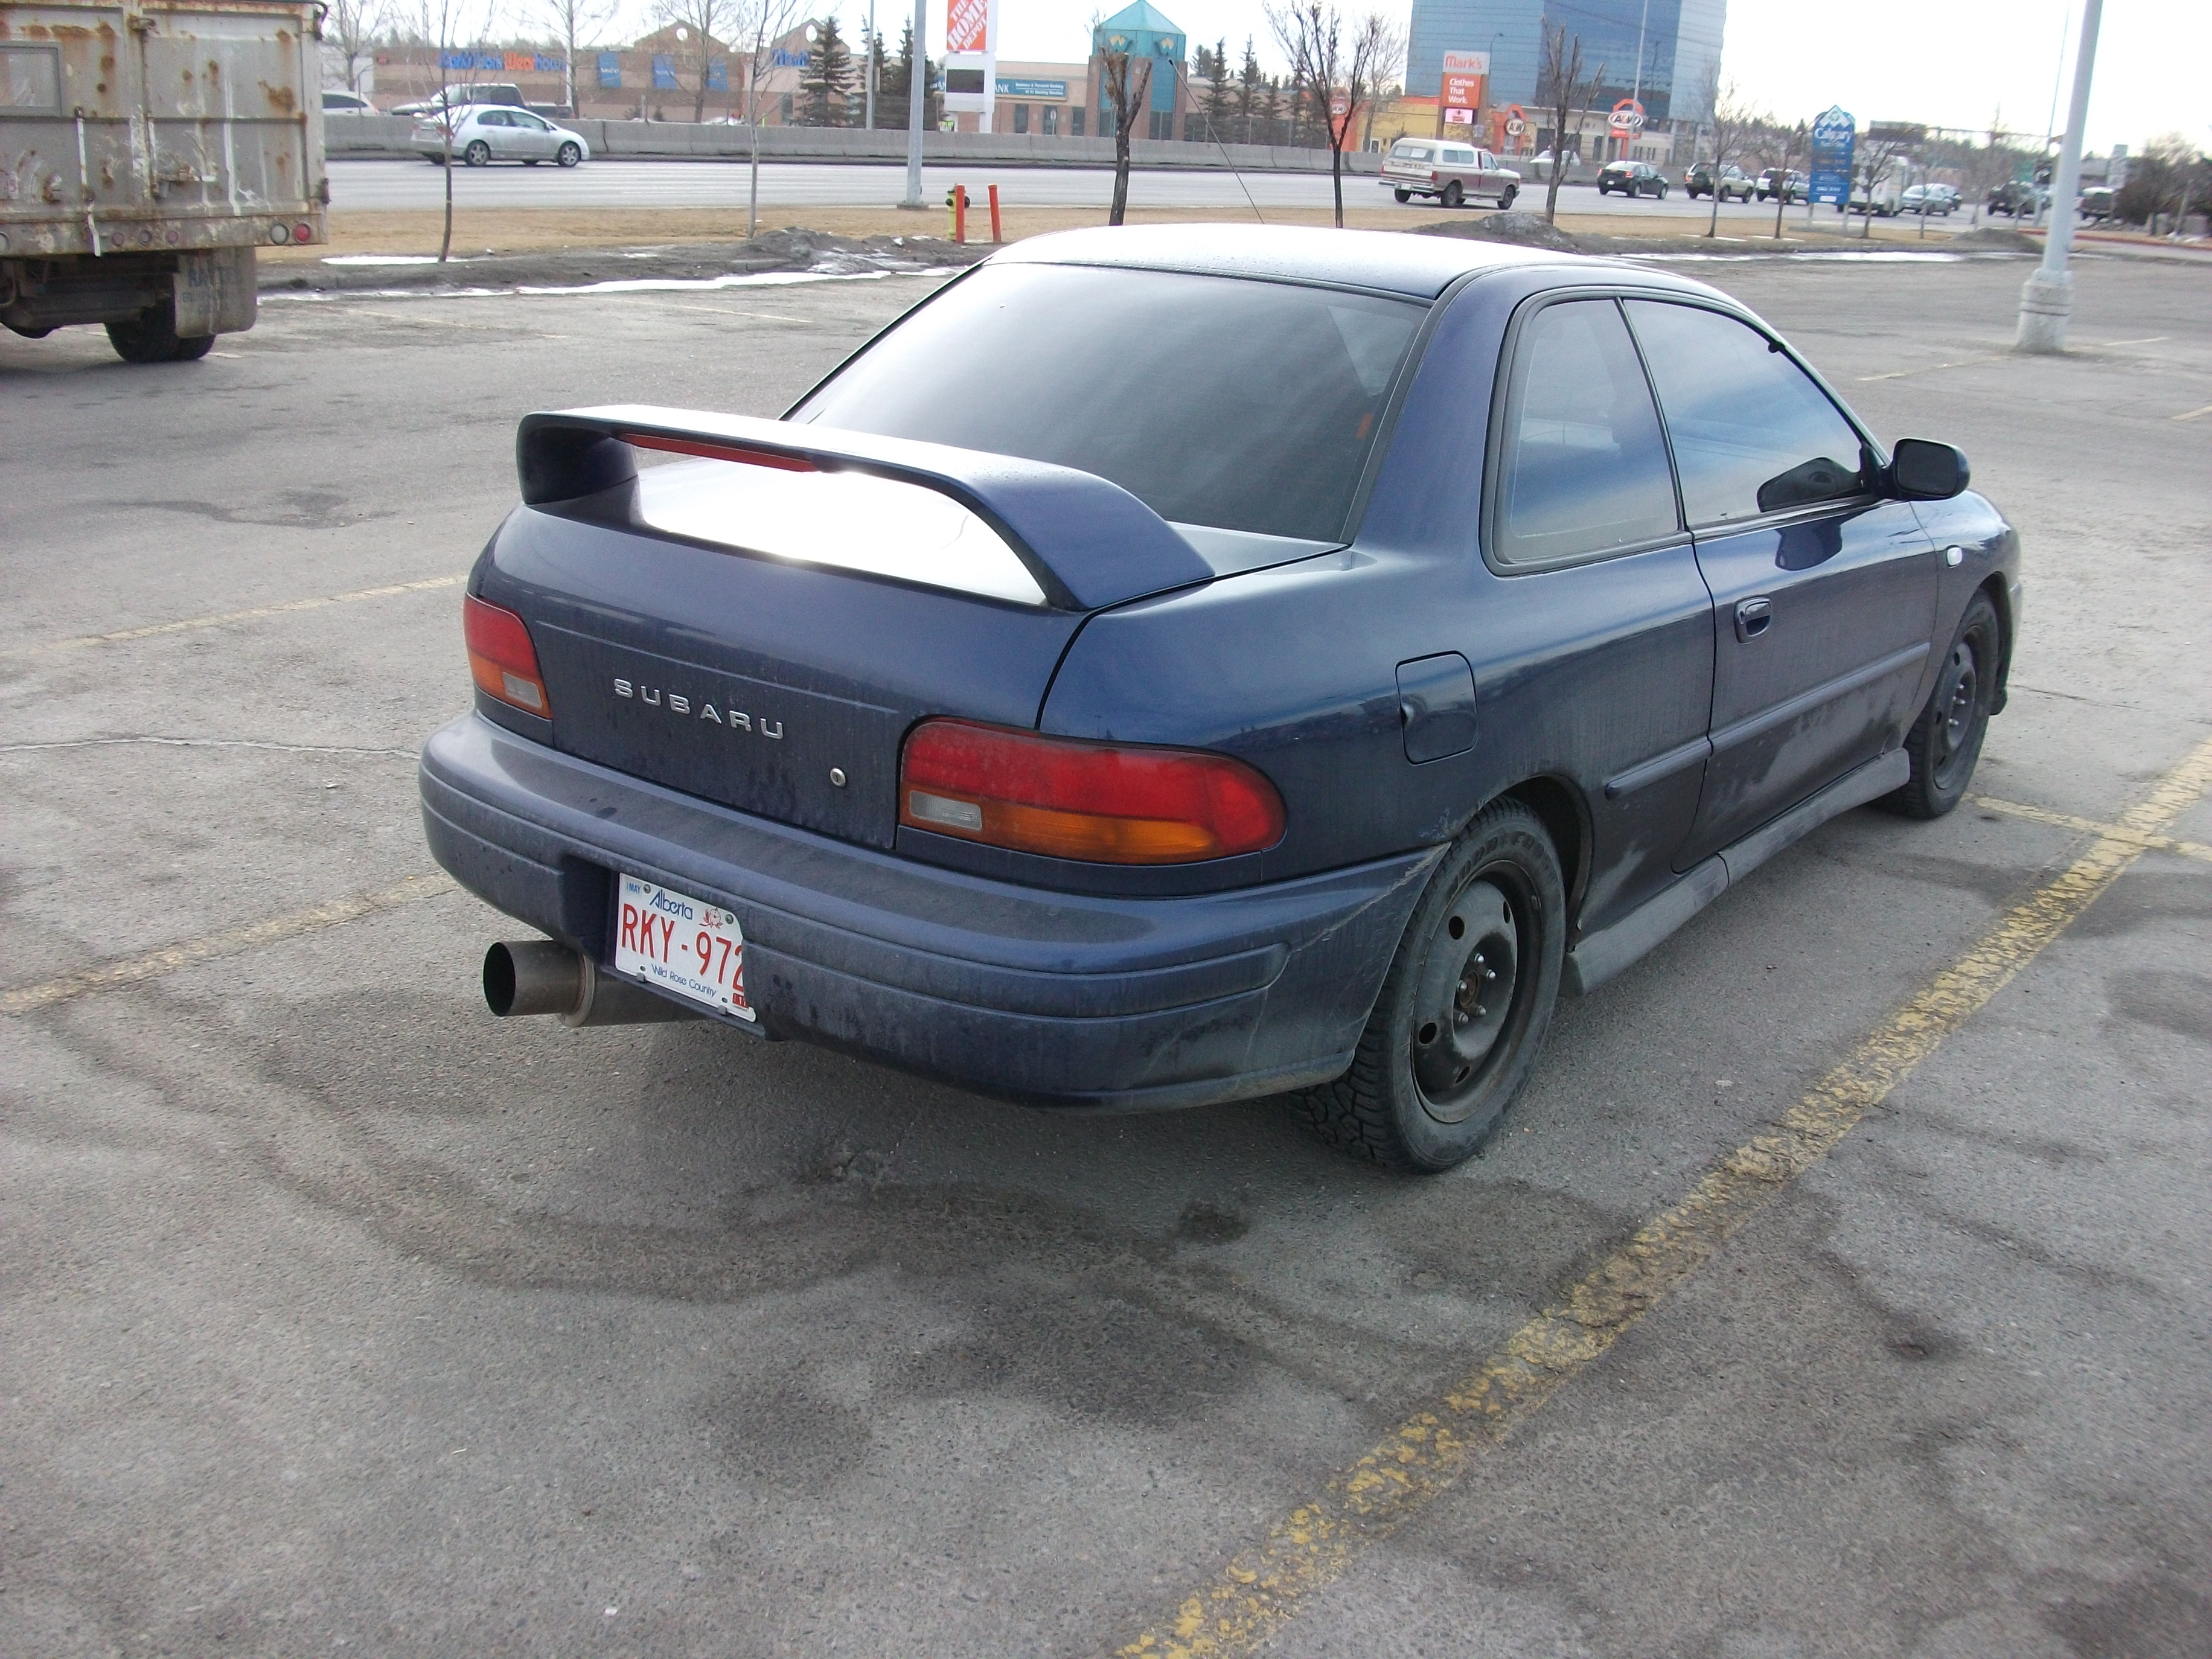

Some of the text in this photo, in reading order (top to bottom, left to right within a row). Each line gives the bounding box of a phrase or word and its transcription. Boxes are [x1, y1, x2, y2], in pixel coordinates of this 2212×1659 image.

[950, 0, 967, 22] THE
[947, 0, 986, 50] HOME
[963, 13, 986, 50] DEPOT
[1445, 54, 1483, 69] Mark's
[994, 83, 1009, 94] ANK
[1450, 78, 1474, 87] Clothes
[1509, 122, 1524, 132] A&W
[1814, 127, 1852, 143] Calgary
[613, 678, 784, 740] SUBARU
[649, 888, 694, 921] Alberta
[651, 963, 717, 998] Wild Rose Country
